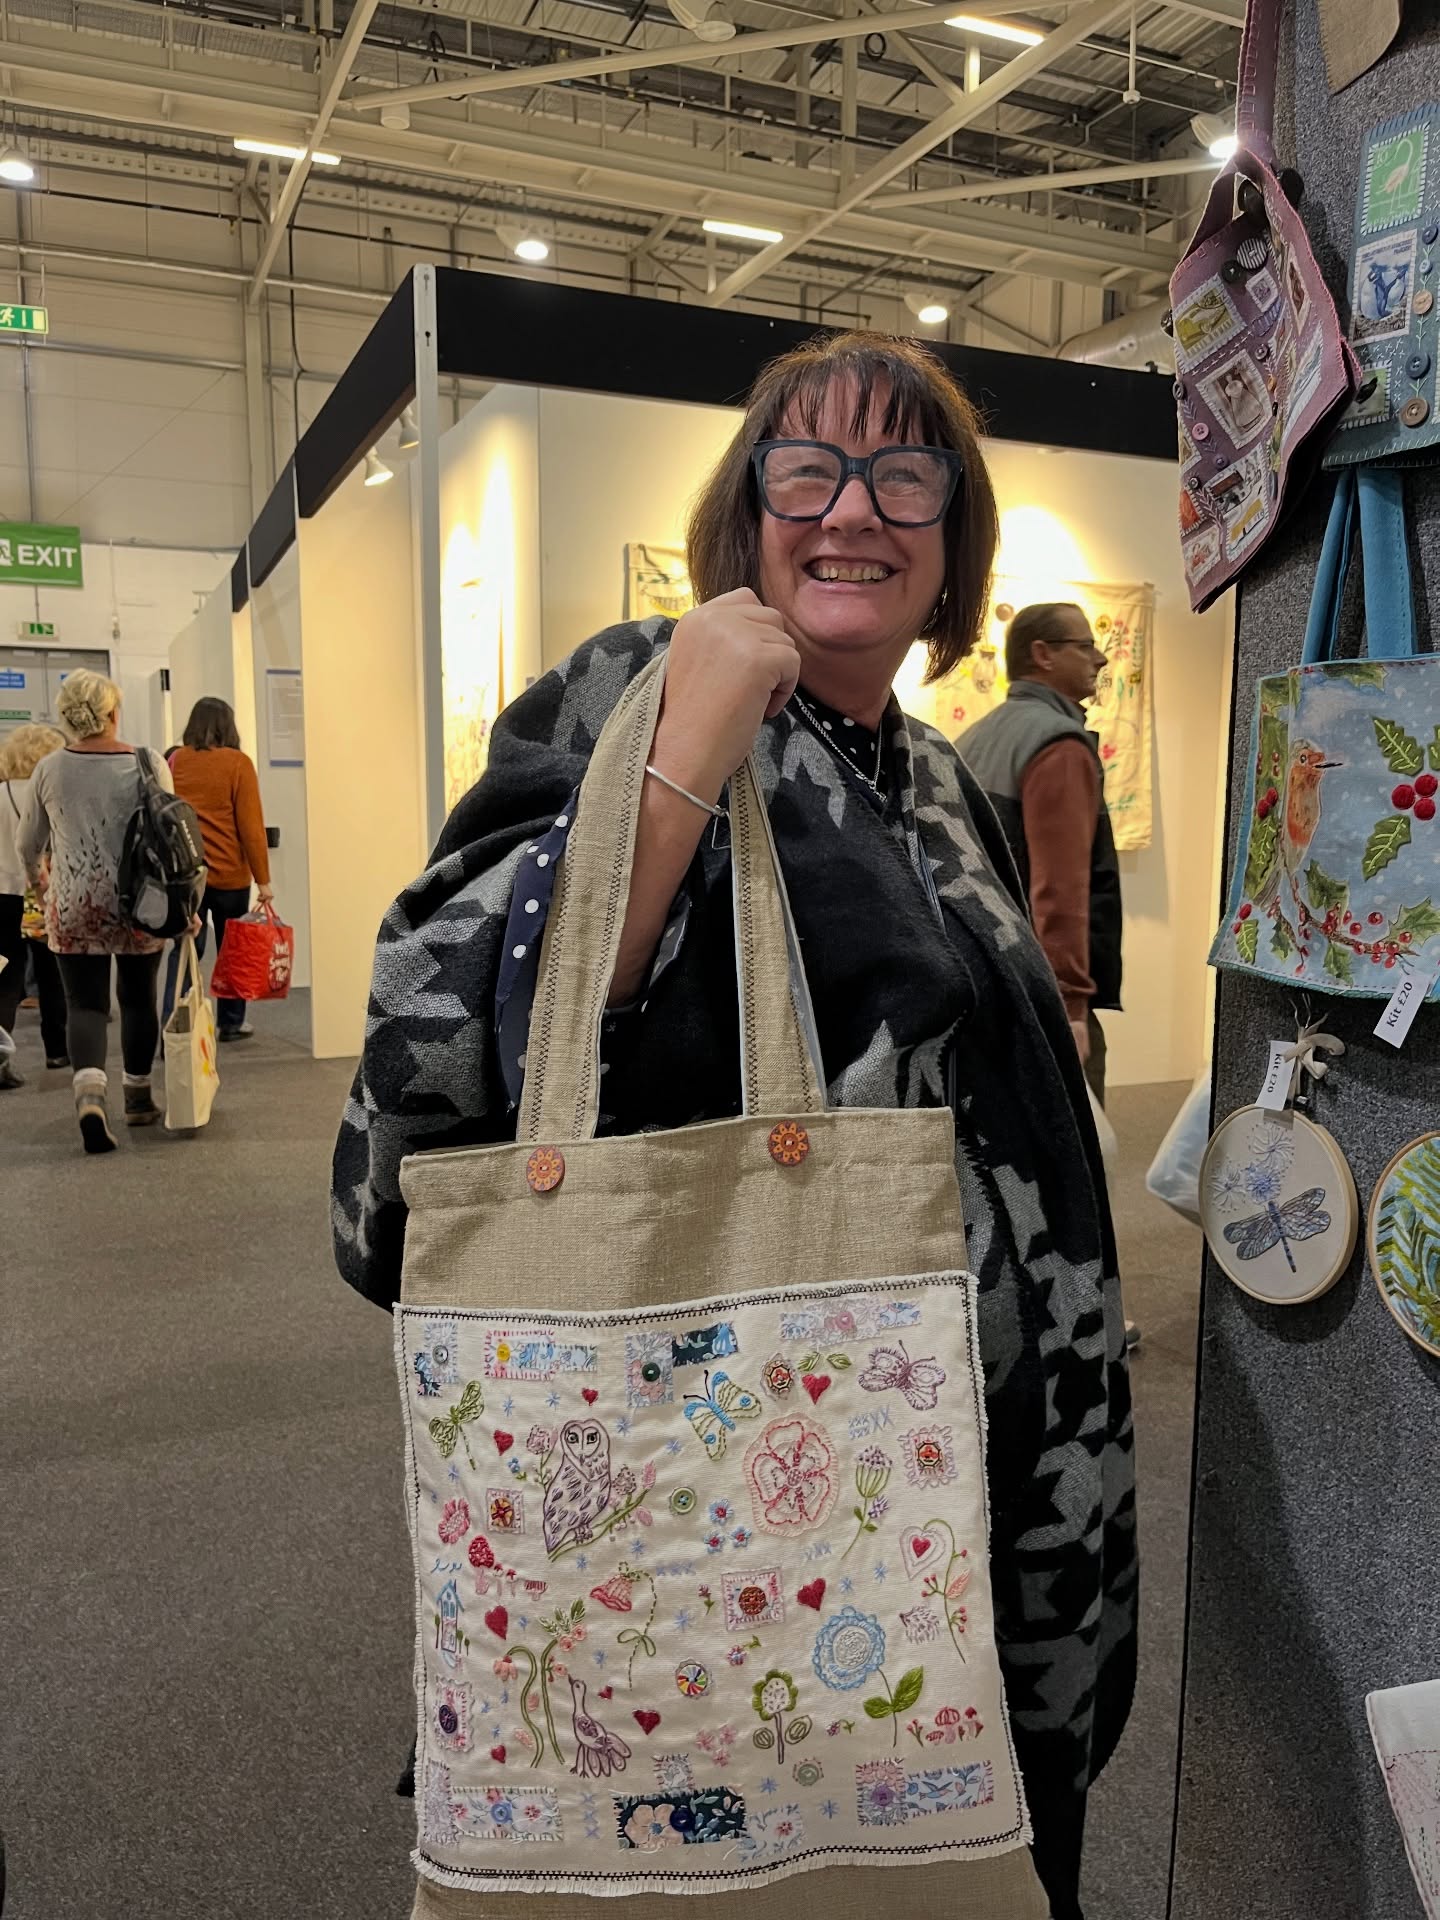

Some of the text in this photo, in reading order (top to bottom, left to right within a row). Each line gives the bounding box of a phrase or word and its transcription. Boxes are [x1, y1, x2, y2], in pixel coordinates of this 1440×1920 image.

[17, 544, 78, 568] EXIT
[1386, 981, 1413, 1028] Kit £20
[1267, 1053, 1282, 1093] Kit £20
